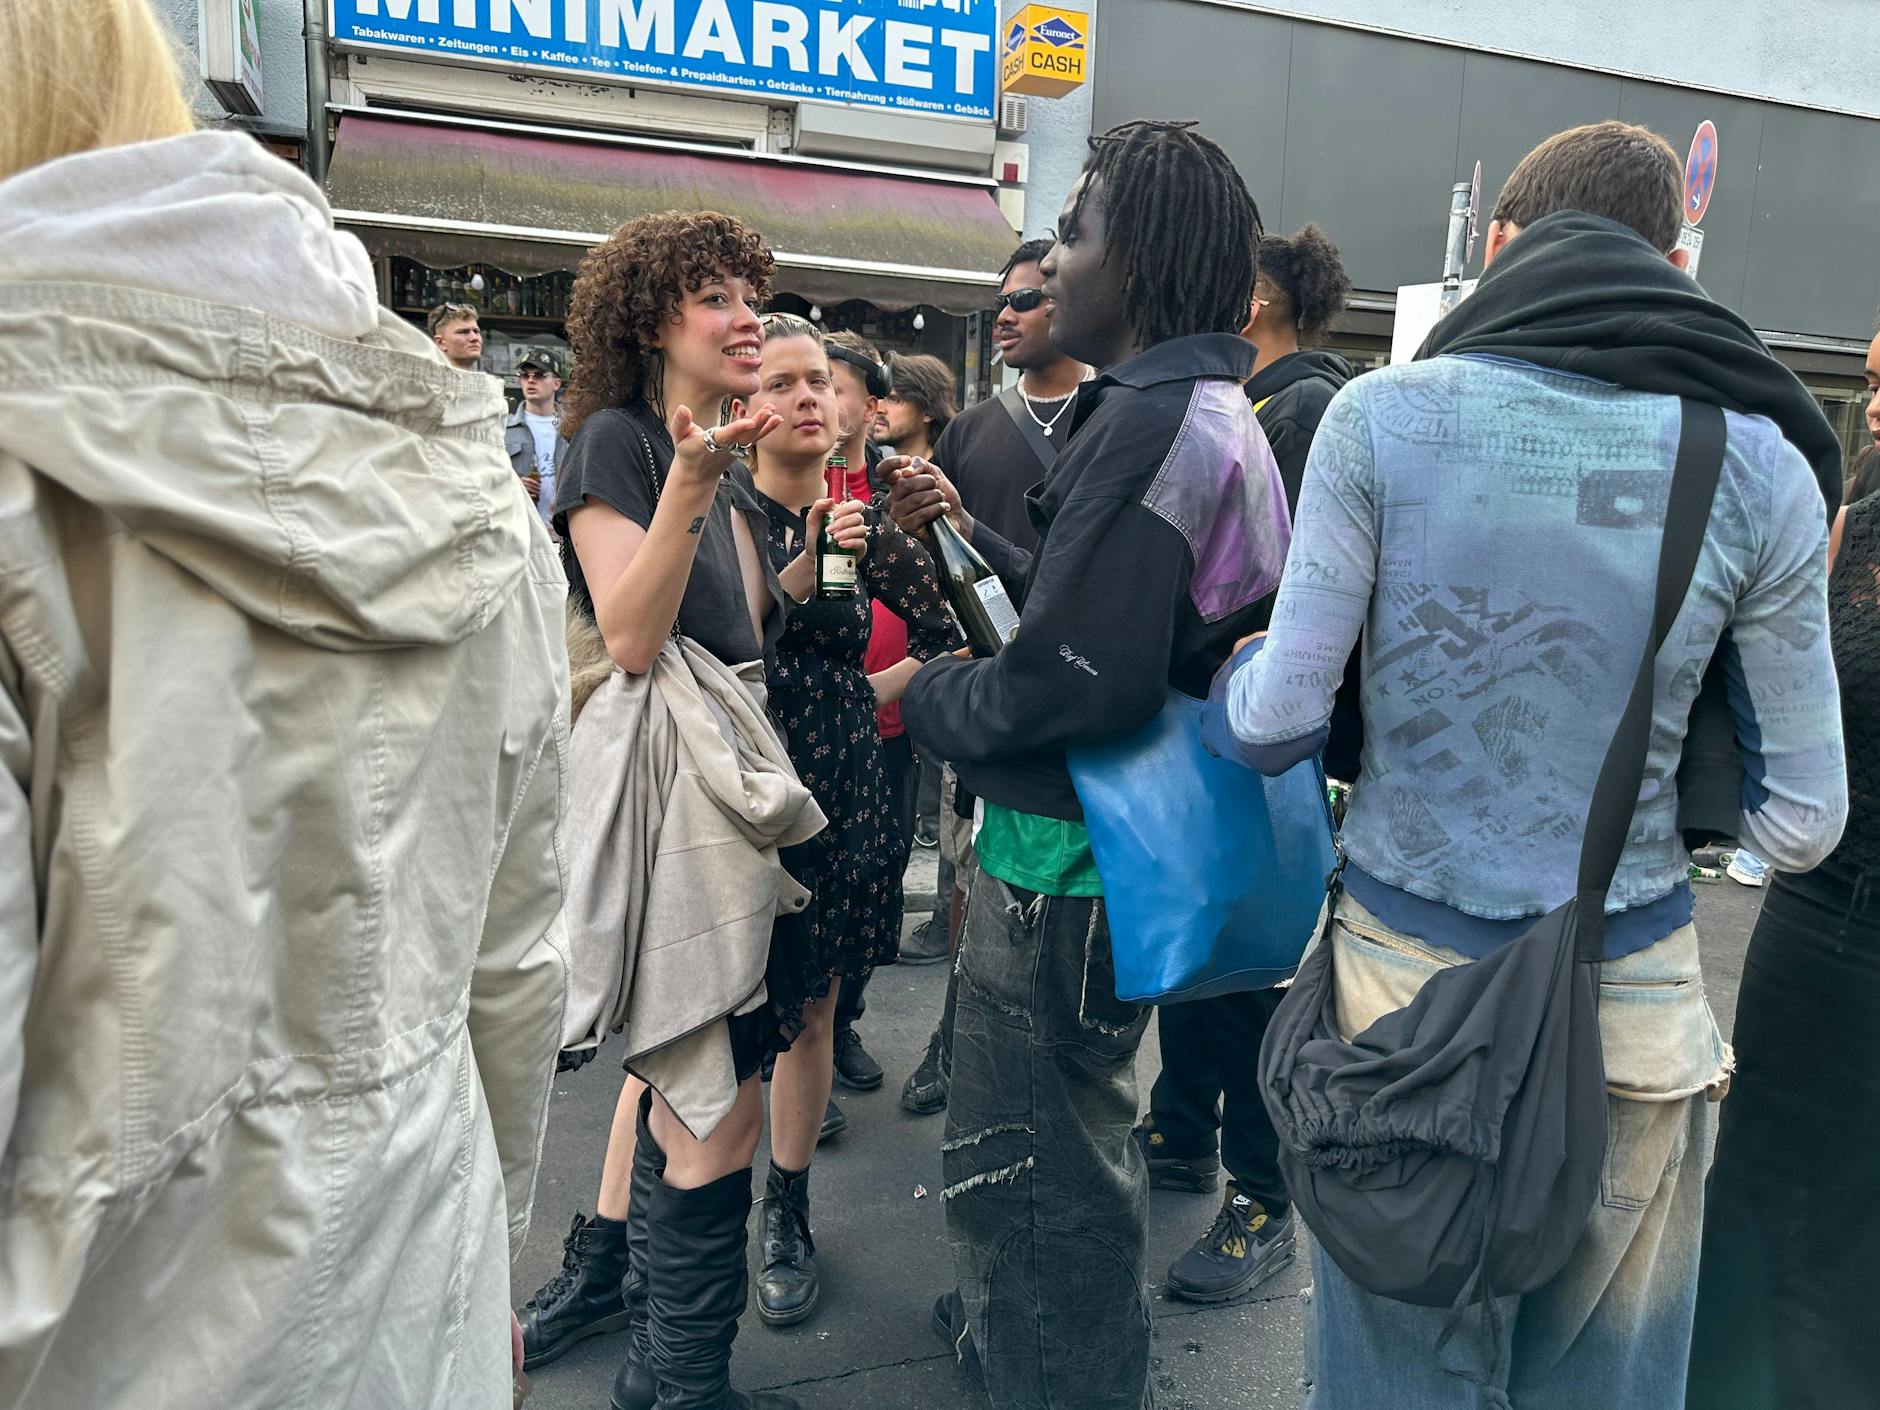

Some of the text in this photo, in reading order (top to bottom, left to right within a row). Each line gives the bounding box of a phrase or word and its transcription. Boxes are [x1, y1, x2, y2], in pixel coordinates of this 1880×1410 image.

[1040, 25, 1075, 40] Euronet
[351, 25, 990, 117] Tabakwaren Zeitungen Eis Kaffee Tee Telefon- & Prepaidkarten Getränke Tiernahrung Süßwaren Gebäck
[1003, 53, 1025, 82] CASH
[1031, 51, 1082, 75] CASH
